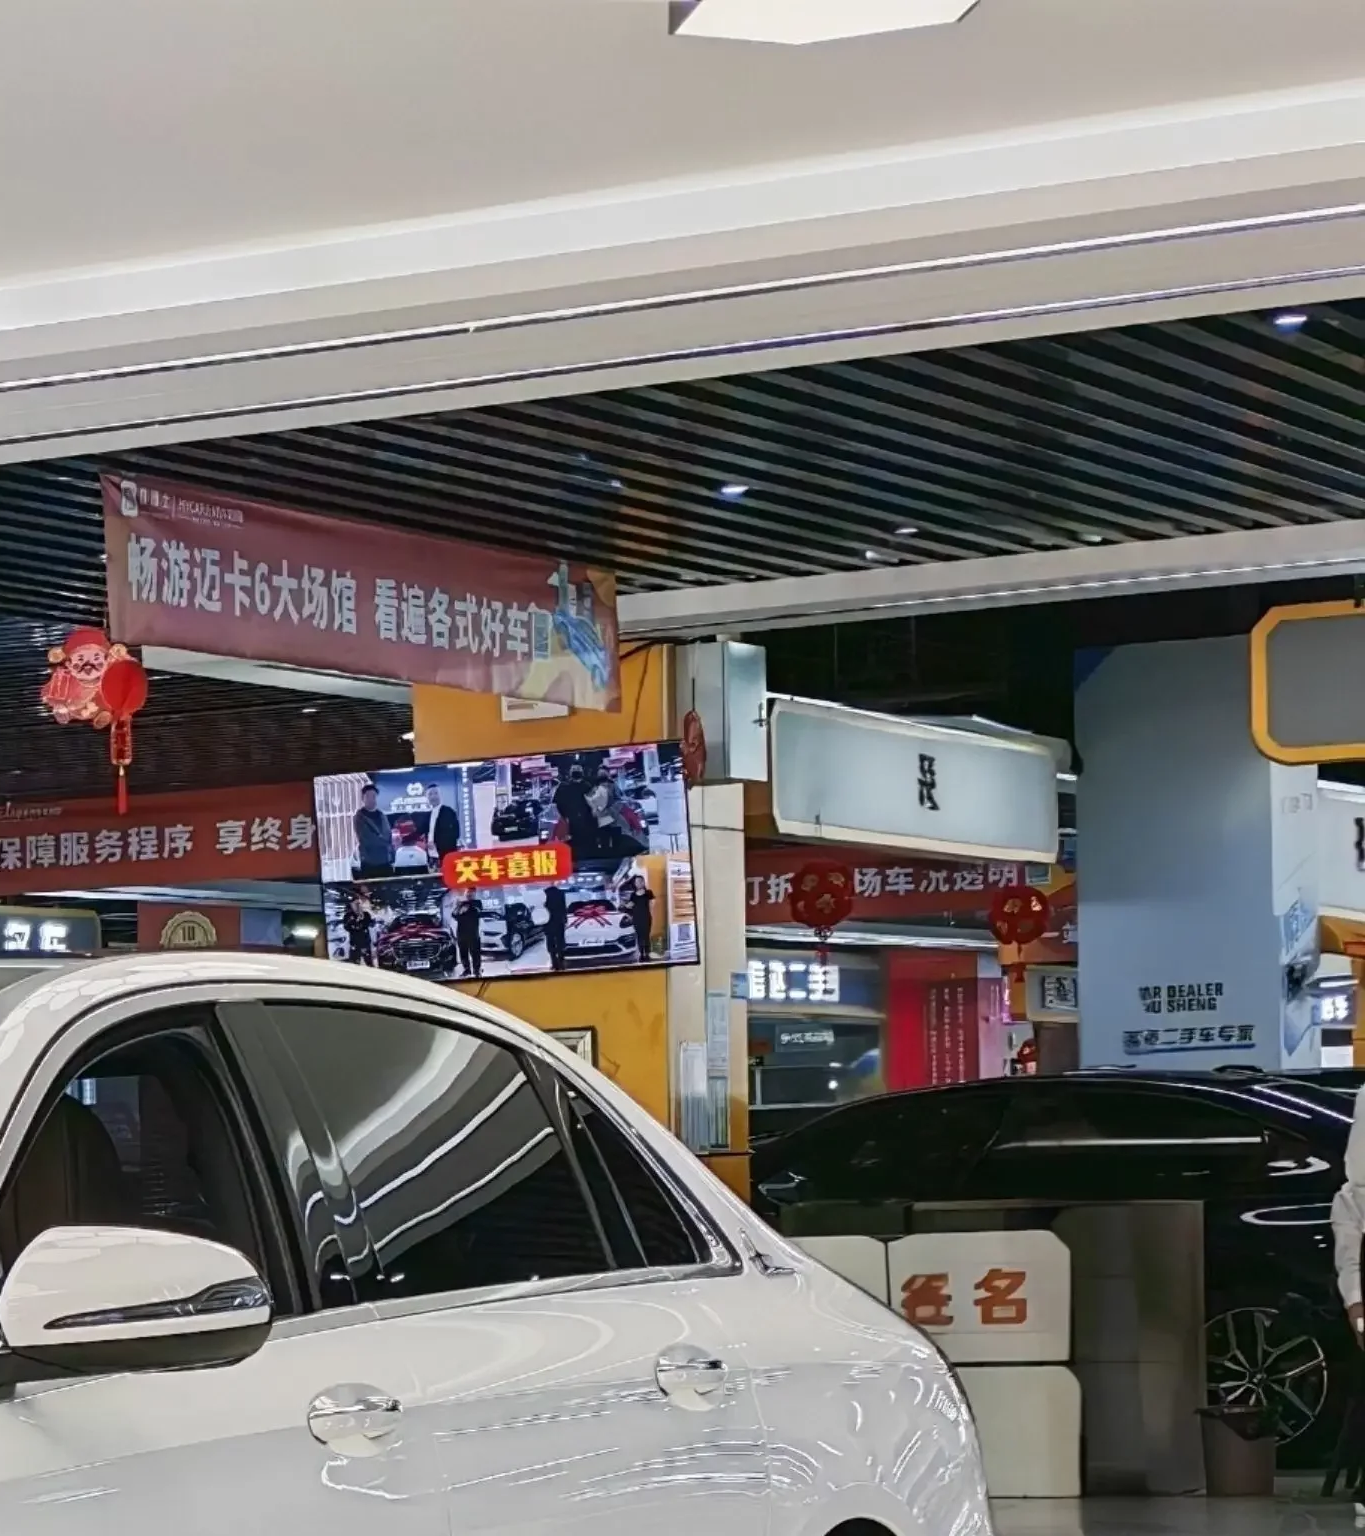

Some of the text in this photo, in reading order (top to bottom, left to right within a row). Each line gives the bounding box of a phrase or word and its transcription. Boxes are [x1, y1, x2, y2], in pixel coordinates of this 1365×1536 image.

[128, 532, 530, 661] 畅游迈卡6大场馆 看遍各式好车
[215, 814, 316, 855] 享终身
[454, 850, 558, 883] 交车喜报
[1167, 982, 1224, 998] DEALER
[1167, 996, 1217, 1013] SHENG
